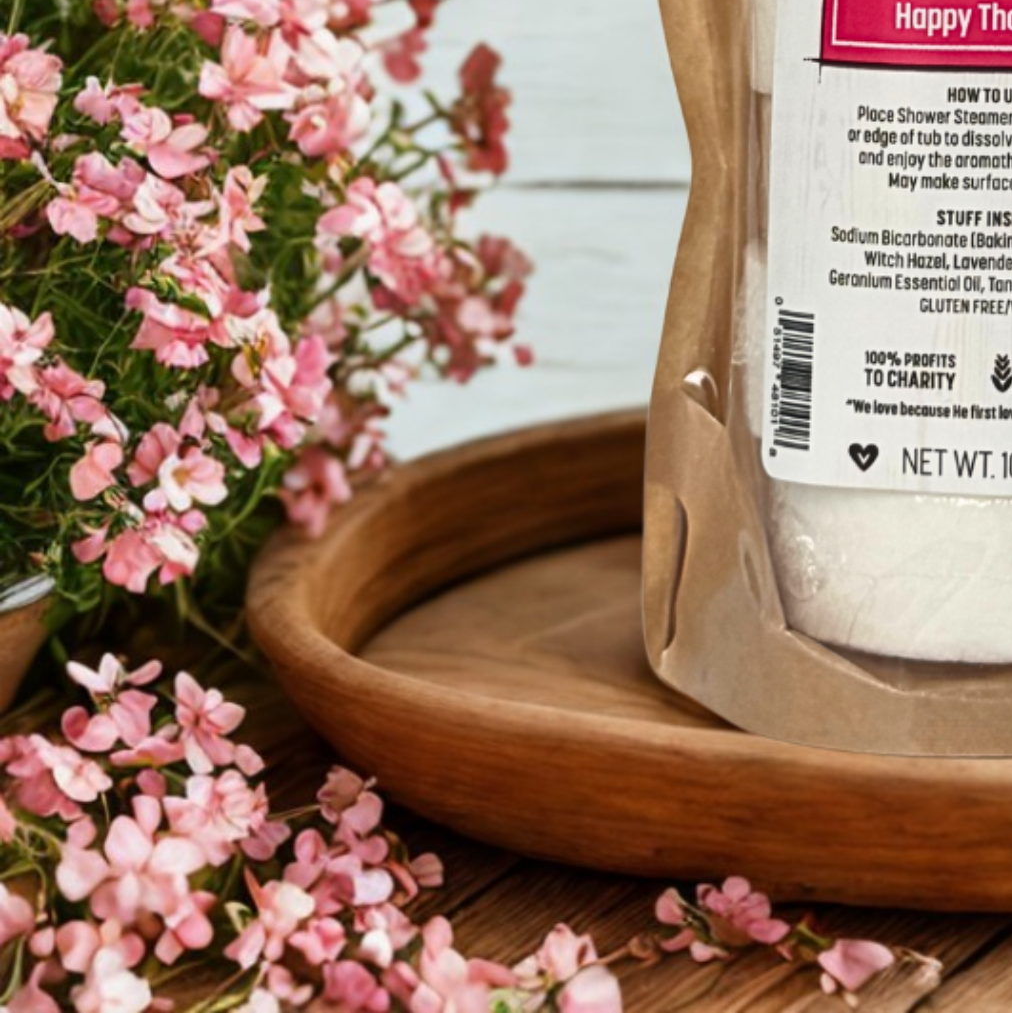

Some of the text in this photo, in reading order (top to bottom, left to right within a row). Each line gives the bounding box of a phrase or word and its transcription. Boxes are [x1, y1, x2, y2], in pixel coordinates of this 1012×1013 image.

[895, 1, 972, 36] Happy
[947, 87, 981, 103] HOW
[983, 88, 1000, 103] TO
[857, 105, 895, 124] Place
[897, 107, 950, 125] Shower
[954, 109, 1012, 126] Steamer
[847, 129, 861, 143] or
[863, 128, 897, 148] edge
[900, 130, 915, 145] of
[917, 131, 942, 147] tub
[944, 133, 959, 147] to
[858, 151, 885, 166] and
[887, 153, 925, 170] enjoy
[928, 152, 952, 168] the
[888, 174, 917, 191] May
[920, 175, 959, 191] make
[936, 210, 982, 226] STUFF
[831, 226, 879, 244] Sodium
[881, 230, 968, 248] Bicarbonate
[864, 250, 904, 268] Witch
[907, 252, 950, 270] Hazel,
[829, 269, 892, 288] Geranium
[895, 274, 960, 291] Essential
[963, 275, 985, 291] Oil,
[919, 298, 970, 314] GLUTEN
[864, 350, 956, 368] 100% PROFITS
[864, 368, 956, 390] TO CHARITY
[873, 400, 898, 415] love
[900, 402, 951, 418] because
[953, 405, 968, 419] He
[971, 405, 996, 419] first
[902, 447, 948, 476] NET
[954, 449, 995, 479] WT.
